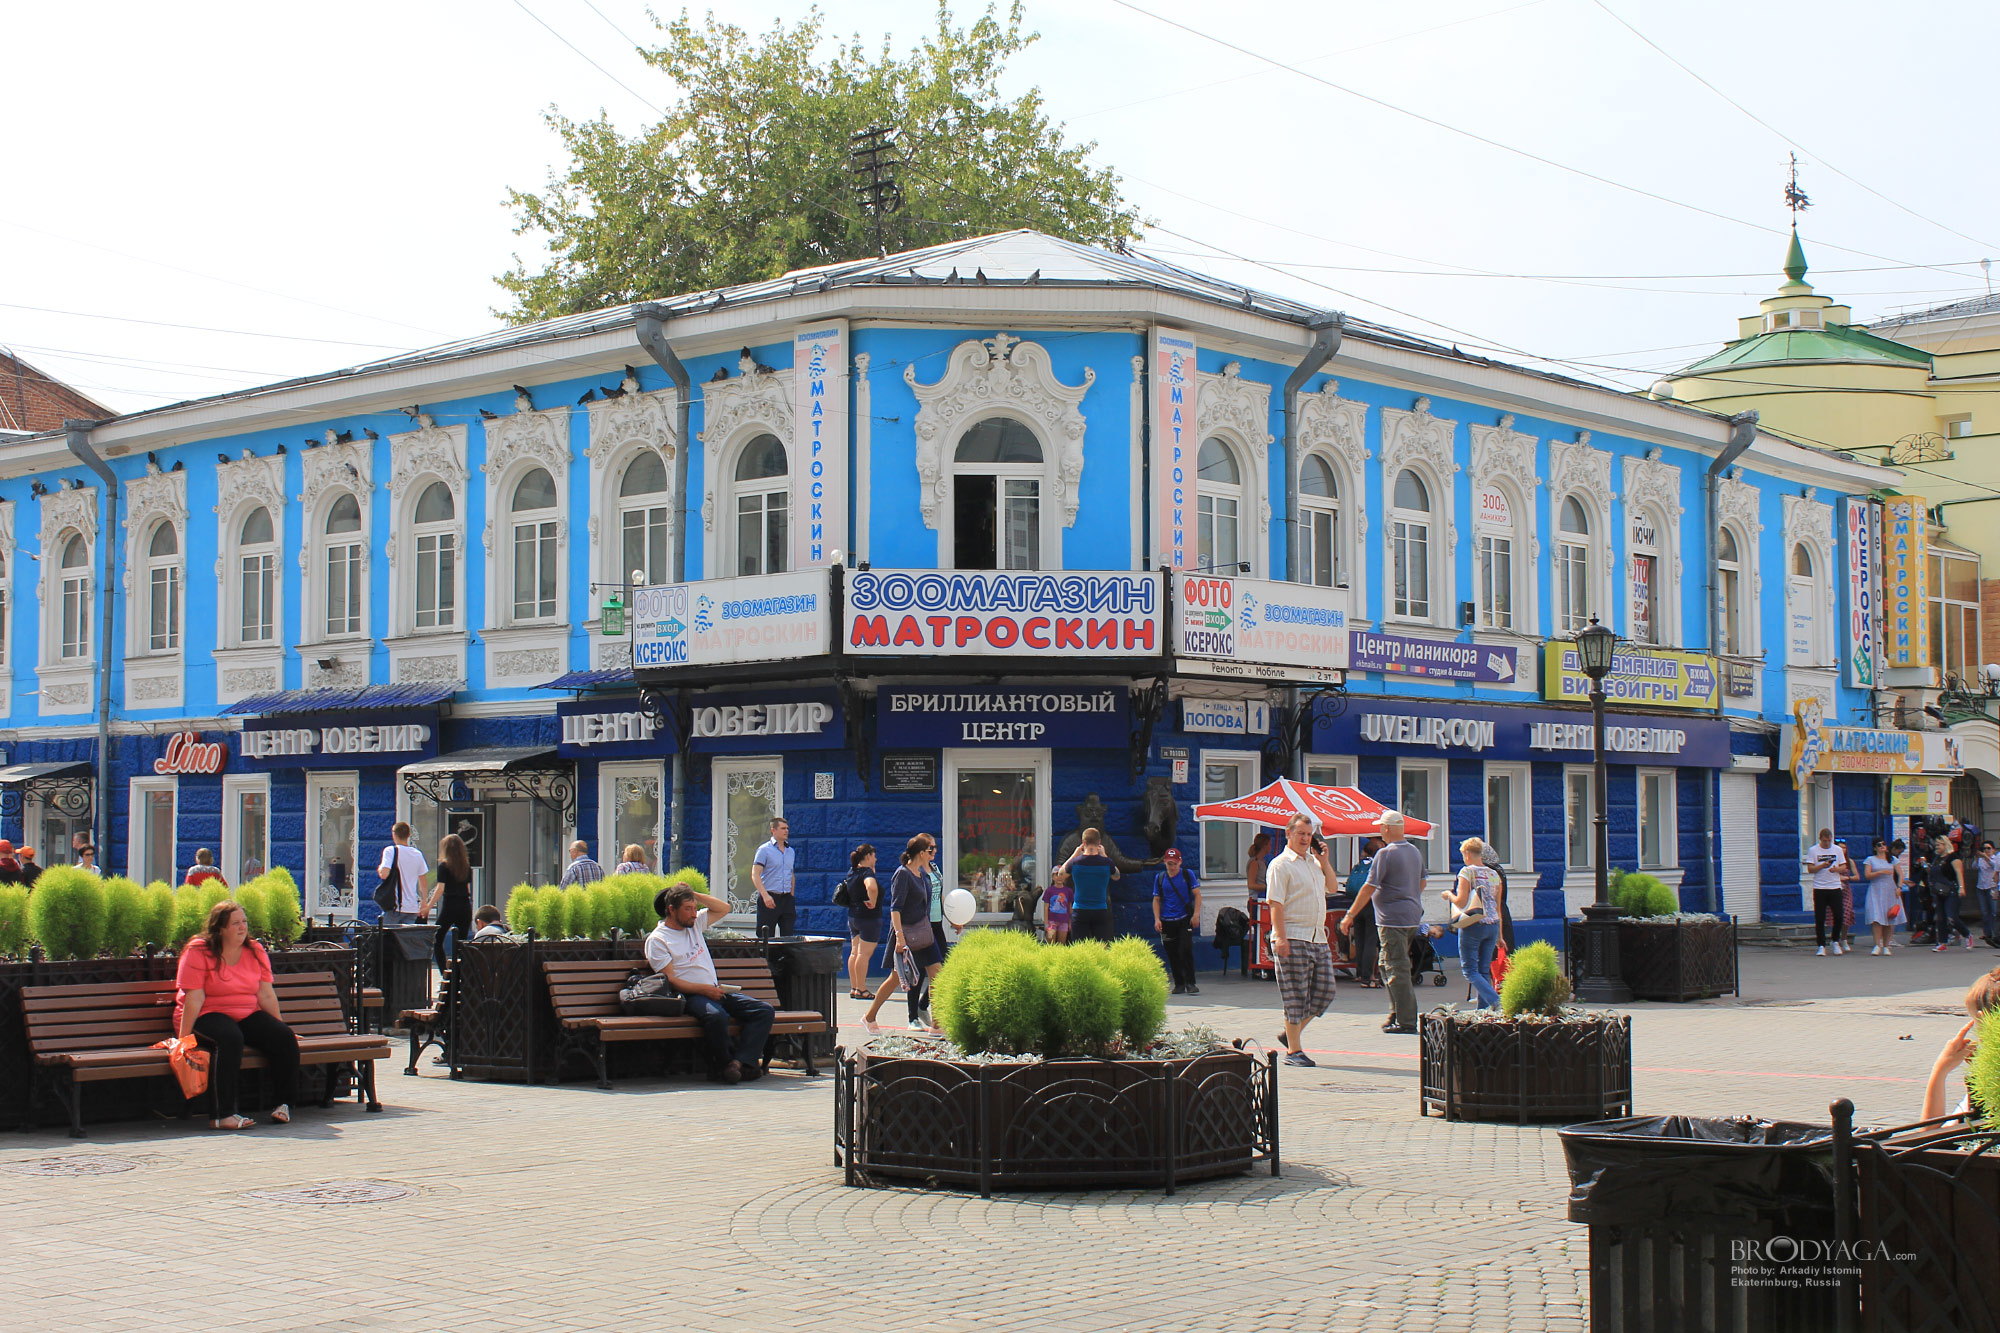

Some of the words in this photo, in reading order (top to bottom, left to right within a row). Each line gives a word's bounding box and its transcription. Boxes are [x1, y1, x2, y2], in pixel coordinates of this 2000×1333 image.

[810, 379, 824, 562] МАТРОСКИН
[1170, 386, 1184, 568] МАТРОСКИН
[1849, 505, 1860, 641] ФОТО
[1858, 506, 1870, 653] КСЕРОКС
[636, 587, 686, 618] ФОТО
[852, 573, 1155, 613] ЗООМАГАЗИН
[1184, 578, 1232, 609] ФОТО
[1893, 522, 1909, 664] МАТРОСКИН
[1917, 521, 1927, 664] МАТРОСКИН
[721, 594, 817, 620] ЗООМАГАЗИН
[1185, 617, 1189, 625] 5
[1205, 615, 1226, 627] ВХОД
[1264, 603, 1344, 628] ЗООМАГАЗИН
[657, 623, 679, 635] ВХОД
[692, 621, 817, 651] МАТРОСКИН
[852, 614, 1155, 651] МАТРОСКИН
[1184, 631, 1233, 655] КСЕРОКС
[1239, 629, 1344, 656] МАТРОСКИН
[636, 639, 687, 664] КСЕРОКС
[1356, 632, 1401, 662] Центр
[1404, 642, 1478, 668] маникюра
[1428, 667, 1448, 677] студия
[1453, 669, 1476, 678] магазин
[1689, 668, 1710, 683] ВХОД
[890, 690, 1116, 713] БРИЛЛИАНТОВЫЙ
[1562, 676, 1679, 702] ВИЕОИГРЫ
[691, 702, 834, 738] ЮВЕЛИР
[1185, 712, 1244, 729] ПОПОВА
[1213, 703, 1232, 712] УЛИЦА
[1255, 706, 1263, 730] 1
[240, 727, 320, 761] ЦЕНТР
[321, 723, 431, 756] ЮВЕЛИР
[561, 711, 665, 746] ЦЕНТР
[961, 722, 1046, 743] ЦЕНТР
[1360, 713, 1495, 752] UVELIR.COM
[1529, 722, 1595, 753] ЦЕНТ
[1604, 725, 1687, 755] ЮВЕЛИР
[1831, 730, 1910, 754] МАТРОСКИН
[154, 731, 227, 775] Lino
[1840, 755, 1890, 770] ЗООМАГАЗИН
